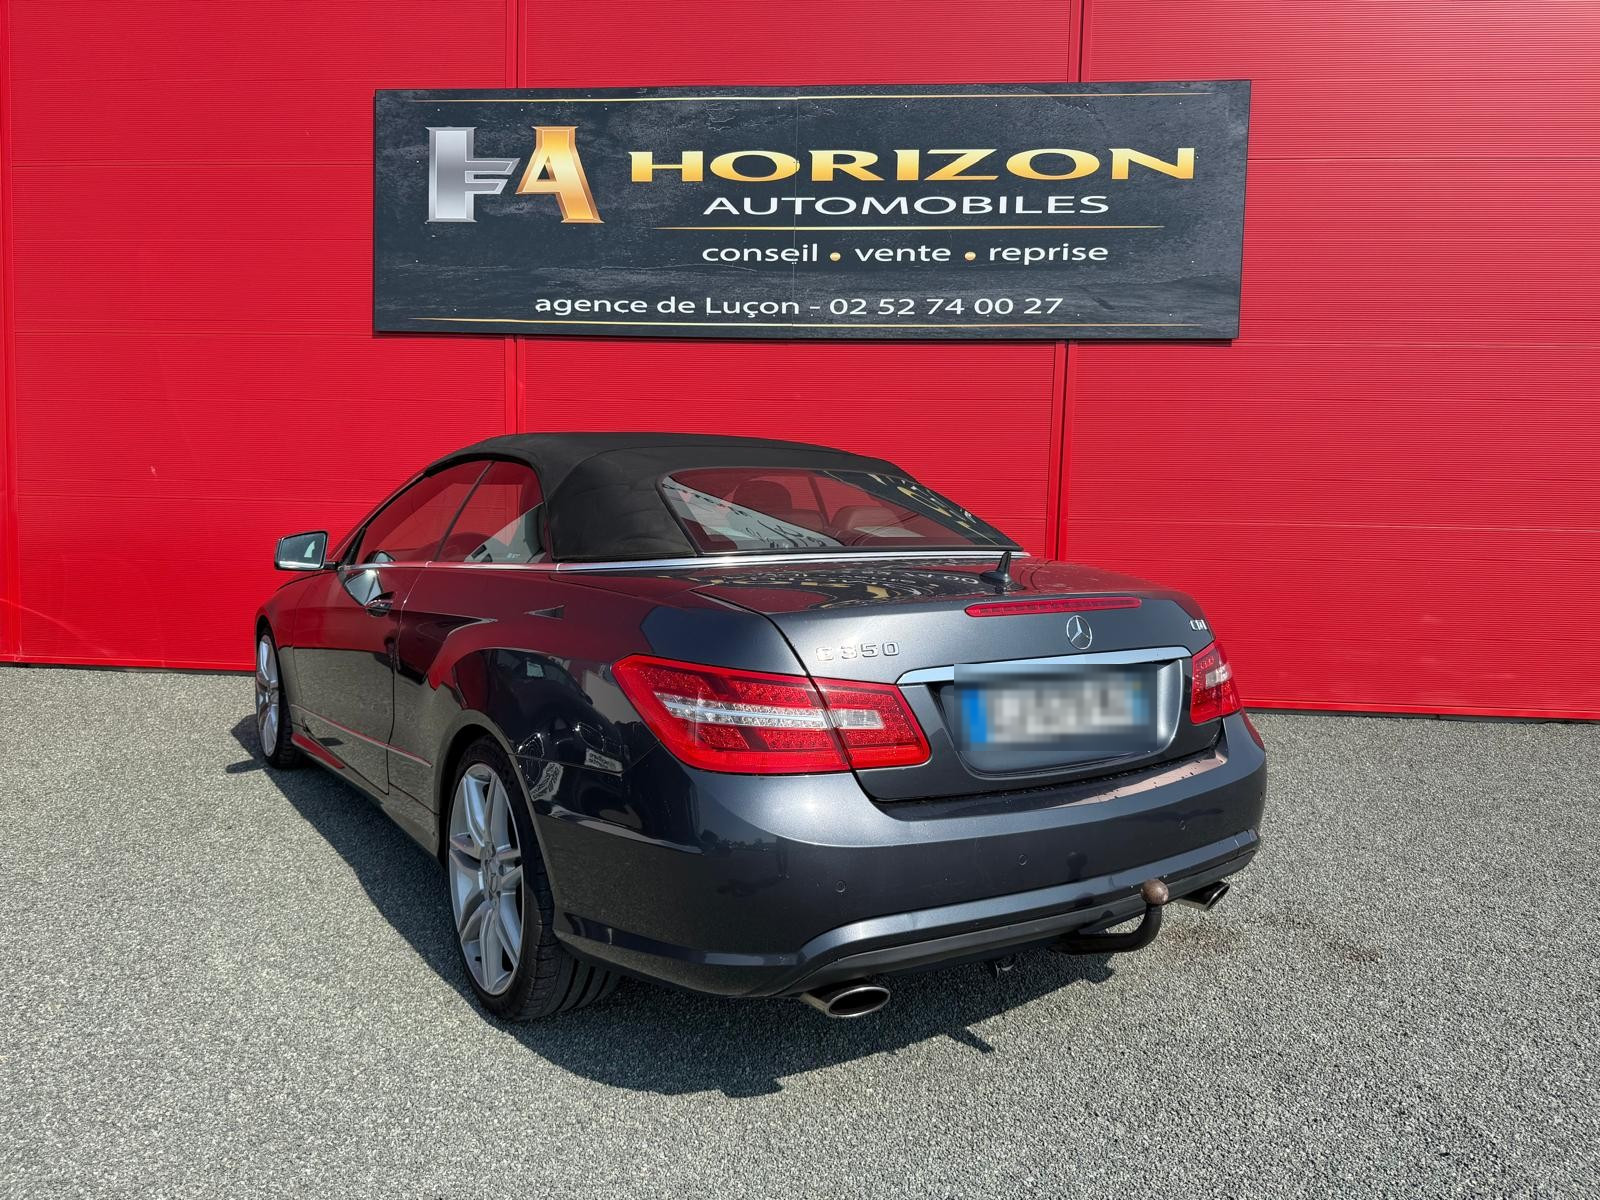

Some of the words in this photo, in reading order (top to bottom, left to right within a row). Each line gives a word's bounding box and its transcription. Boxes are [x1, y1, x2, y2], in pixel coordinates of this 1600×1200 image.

[628, 147, 1195, 183] HORIZON
[703, 195, 1109, 215] AUTOMOBILES
[702, 243, 818, 262] conseil
[855, 245, 951, 262] vente
[989, 243, 1109, 265] reprise
[535, 298, 648, 315] agence
[657, 296, 696, 314] de
[706, 297, 800, 318] Luçon
[829, 298, 867, 315] 02
[877, 298, 915, 315] 52
[926, 298, 965, 315] 74
[974, 298, 1014, 315] 00
[1023, 297, 1064, 315] 27
[840, 641, 900, 660] 350
